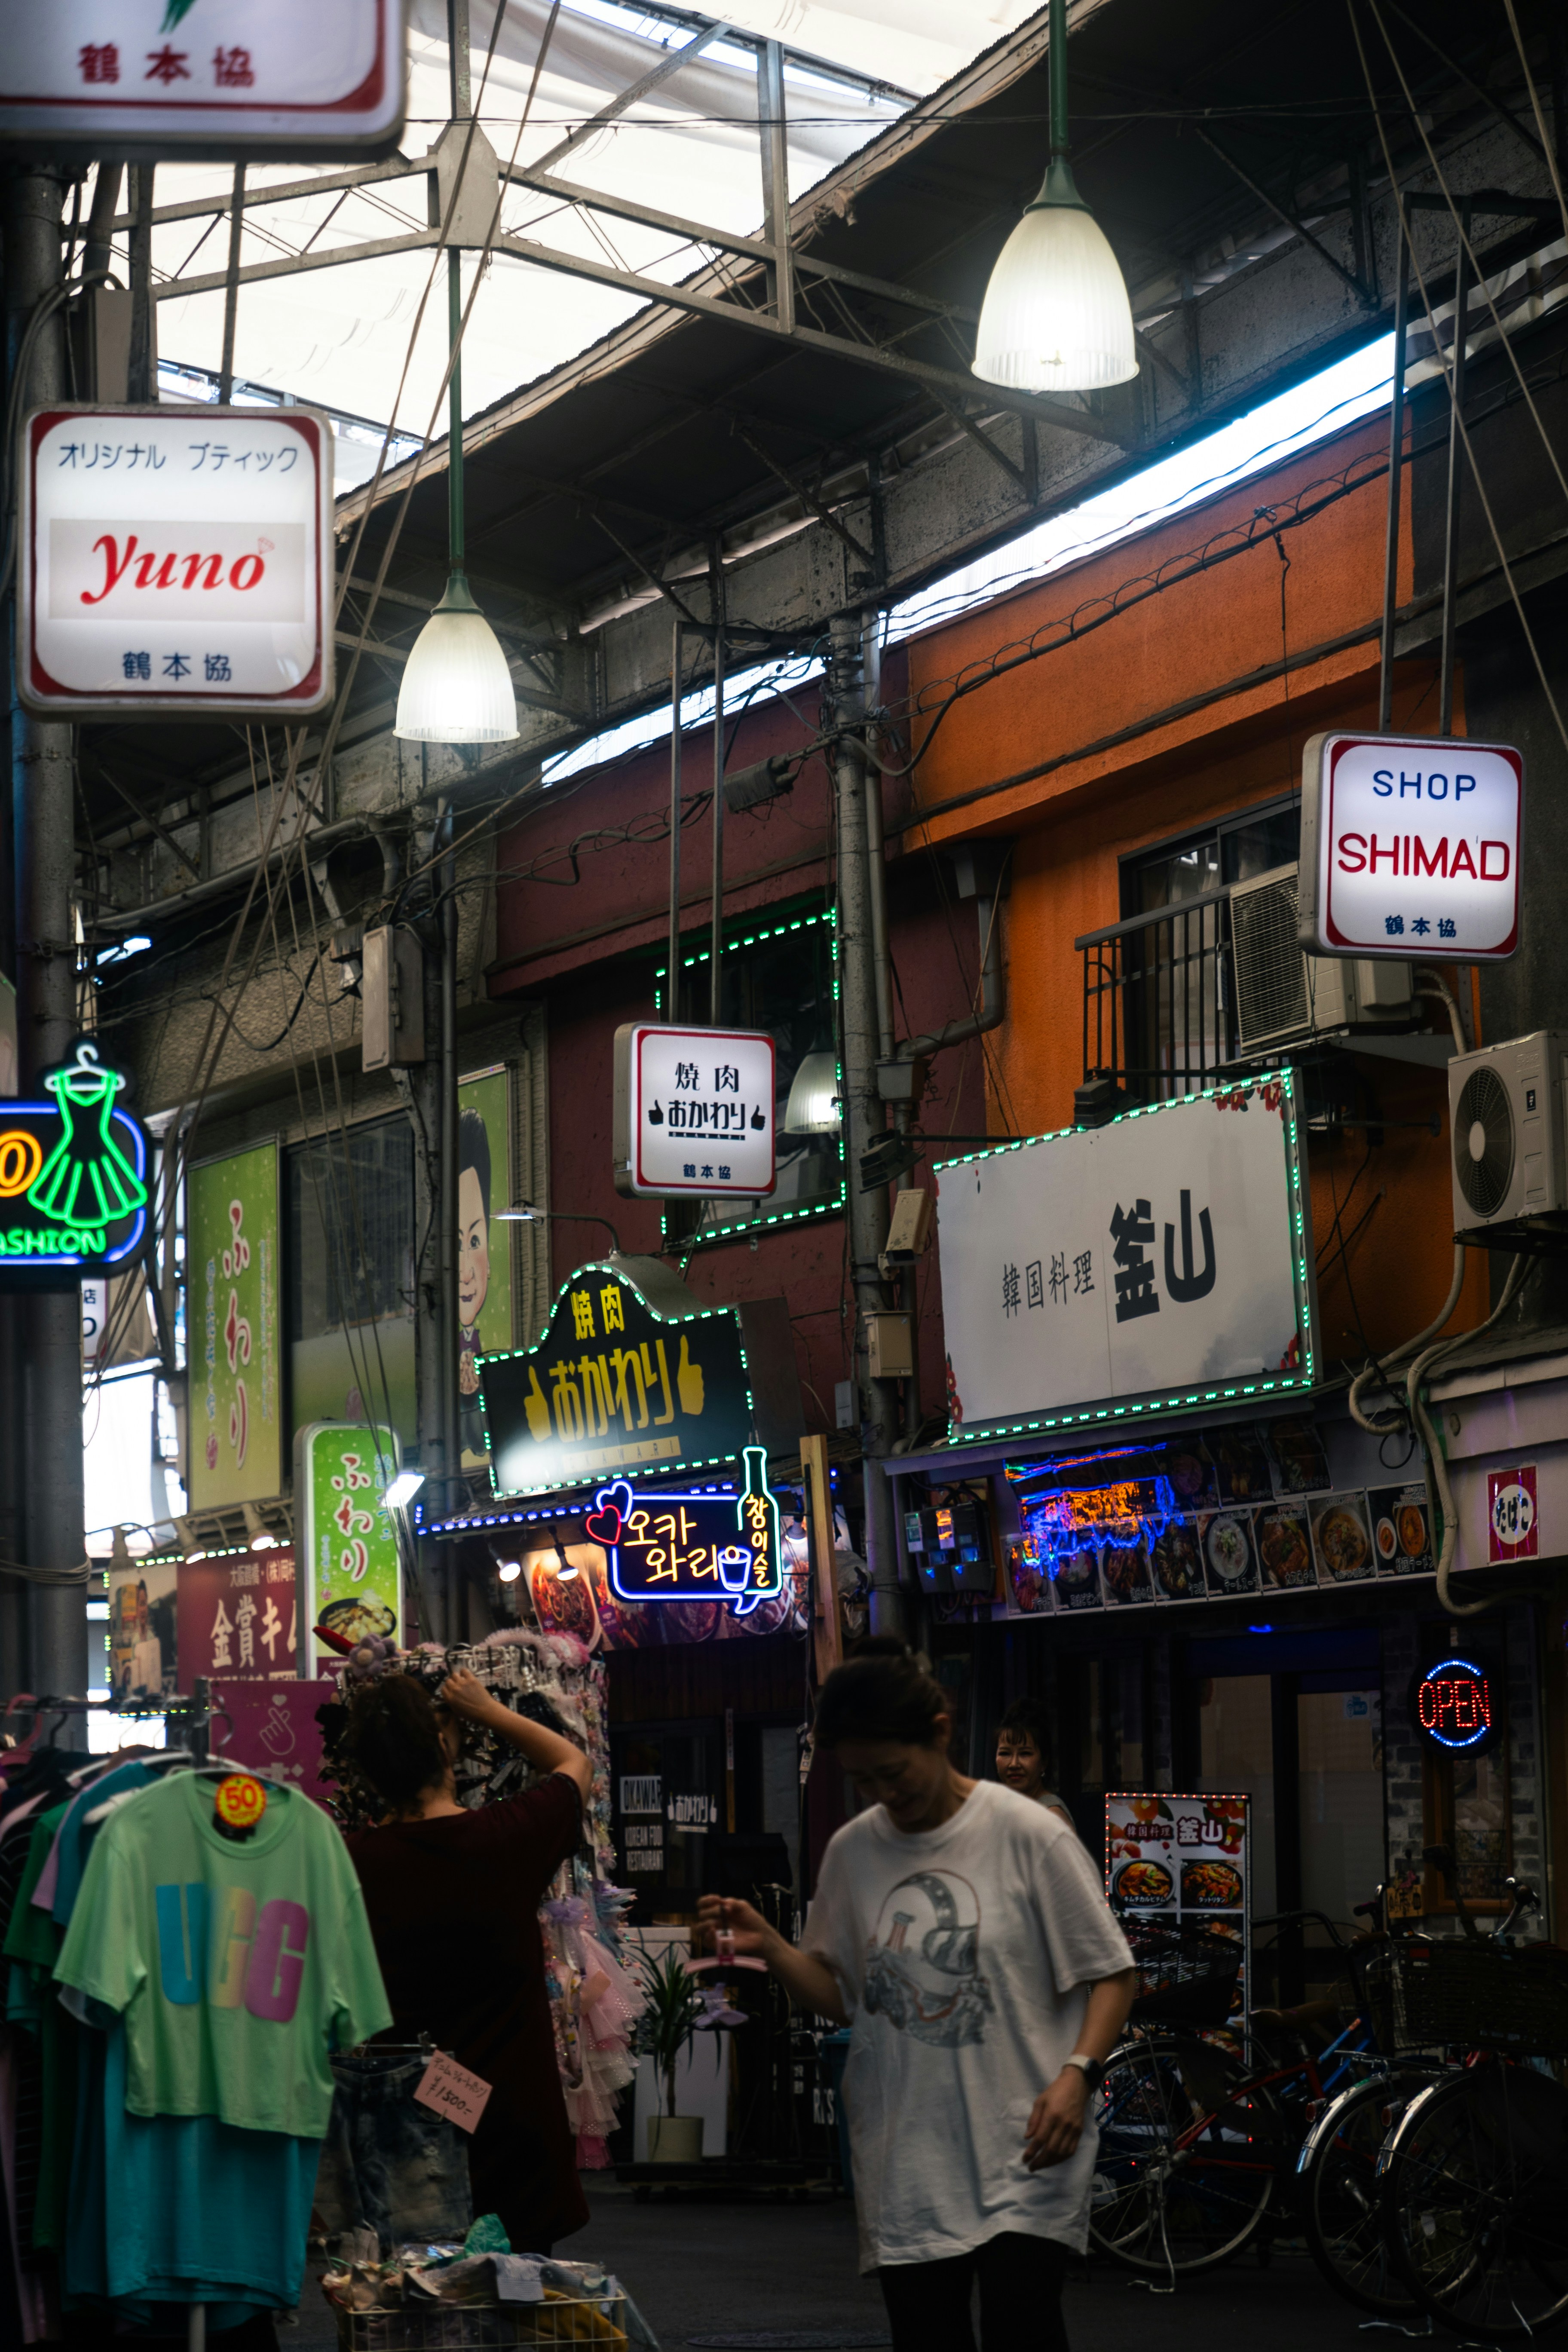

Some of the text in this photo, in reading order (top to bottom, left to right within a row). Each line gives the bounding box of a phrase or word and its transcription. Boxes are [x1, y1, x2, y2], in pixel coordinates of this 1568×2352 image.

[78, 43, 255, 88] 鶴本協
[58, 442, 298, 473] オリジナル ブティック
[80, 534, 265, 605] yuno
[122, 651, 231, 682] 鶴本協
[1373, 770, 1476, 801] SHOP
[1338, 833, 1510, 881] SHIMAD
[1385, 915, 1457, 938] 鶴本協
[675, 1062, 740, 1093] 焼肉
[668, 1099, 746, 1130] おかわり
[683, 1164, 731, 1179] 鶴本協
[1002, 1189, 1216, 1323] 韓国料理 釜山
[571, 1284, 625, 1340] 焼肉
[222, 1199, 251, 1470] ふわり
[549, 1339, 675, 1442] おかわり
[331, 1453, 373, 1582] ふわり
[624, 1507, 697, 1547] 오카
[1496, 1496, 1529, 1535] たばこ
[746, 1494, 770, 1587] 참이슬
[646, 1542, 719, 1583] 와리
[1419, 1680, 1491, 1727] OPEN
[226, 1783, 257, 1810] 50
[1126, 1817, 1224, 1844] 韓国料理 釜山
